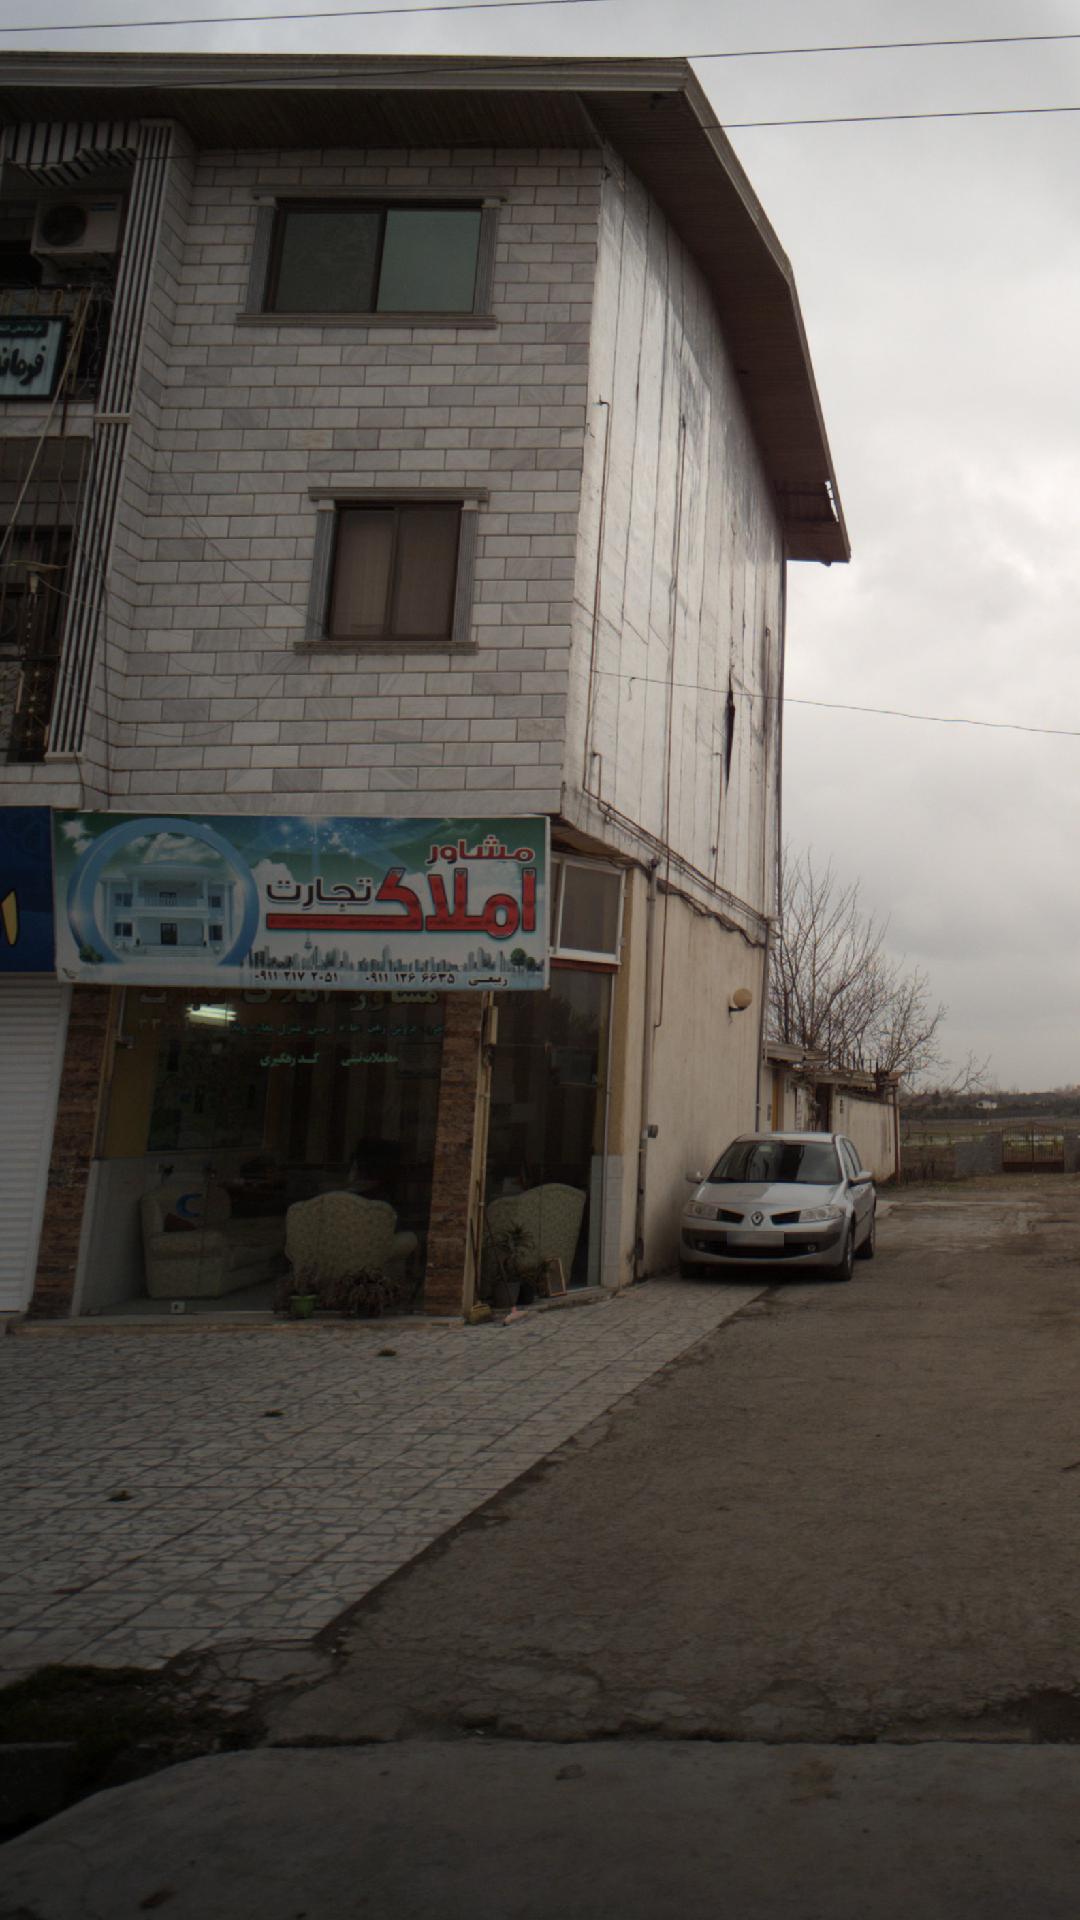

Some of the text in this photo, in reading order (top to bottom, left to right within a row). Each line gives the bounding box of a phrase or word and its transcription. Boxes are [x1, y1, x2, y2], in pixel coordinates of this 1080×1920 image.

[426, 835, 535, 864] مشاور
[266, 877, 372, 911] تجارت
[266, 867, 537, 940] املاک
[259, 1052, 297, 1068] رهگیری
[297, 1052, 320, 1064] کد
